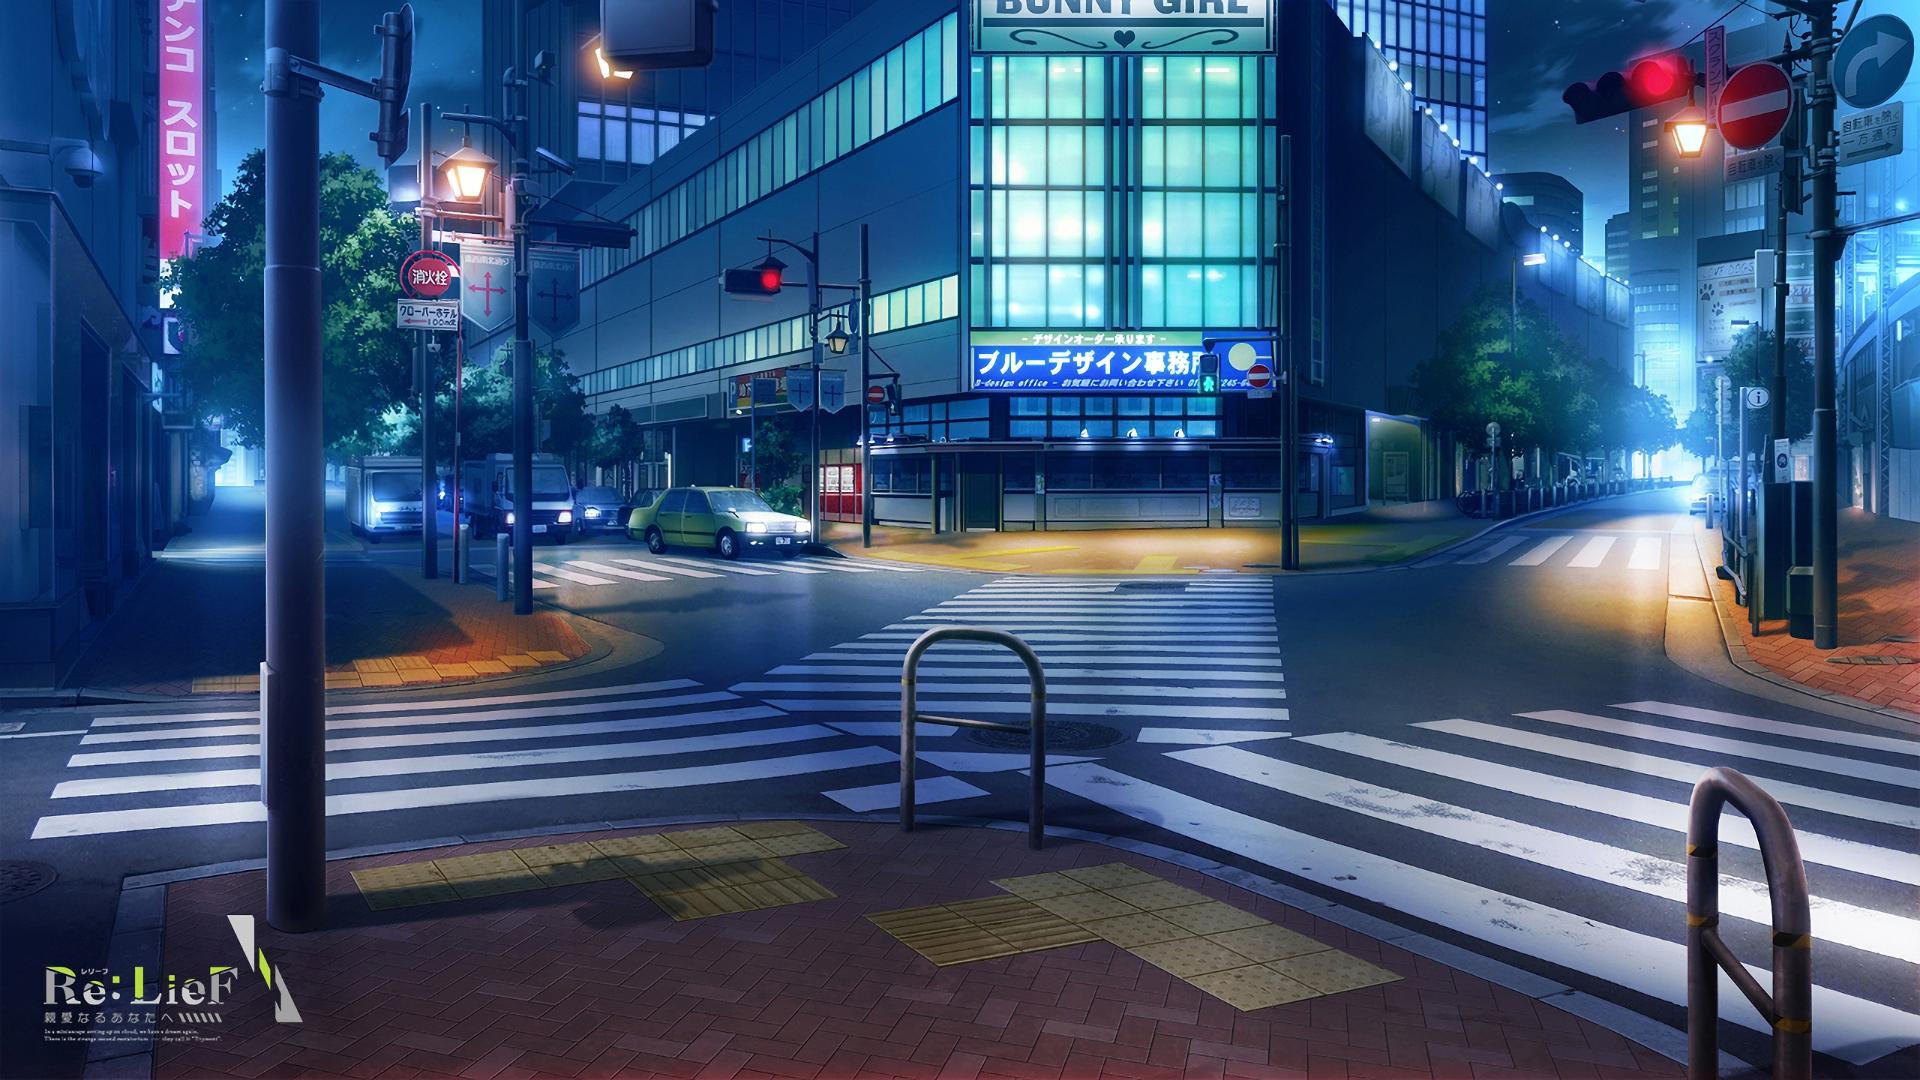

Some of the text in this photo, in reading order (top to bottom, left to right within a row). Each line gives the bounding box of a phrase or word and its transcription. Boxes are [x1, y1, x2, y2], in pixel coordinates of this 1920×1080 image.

[1842, 124, 1898, 146] 一方通行
[164, 99, 198, 219] スロット
[412, 268, 449, 287] 消火栓
[400, 305, 458, 319] クローバーホテル
[1018, 378, 1048, 388] office
